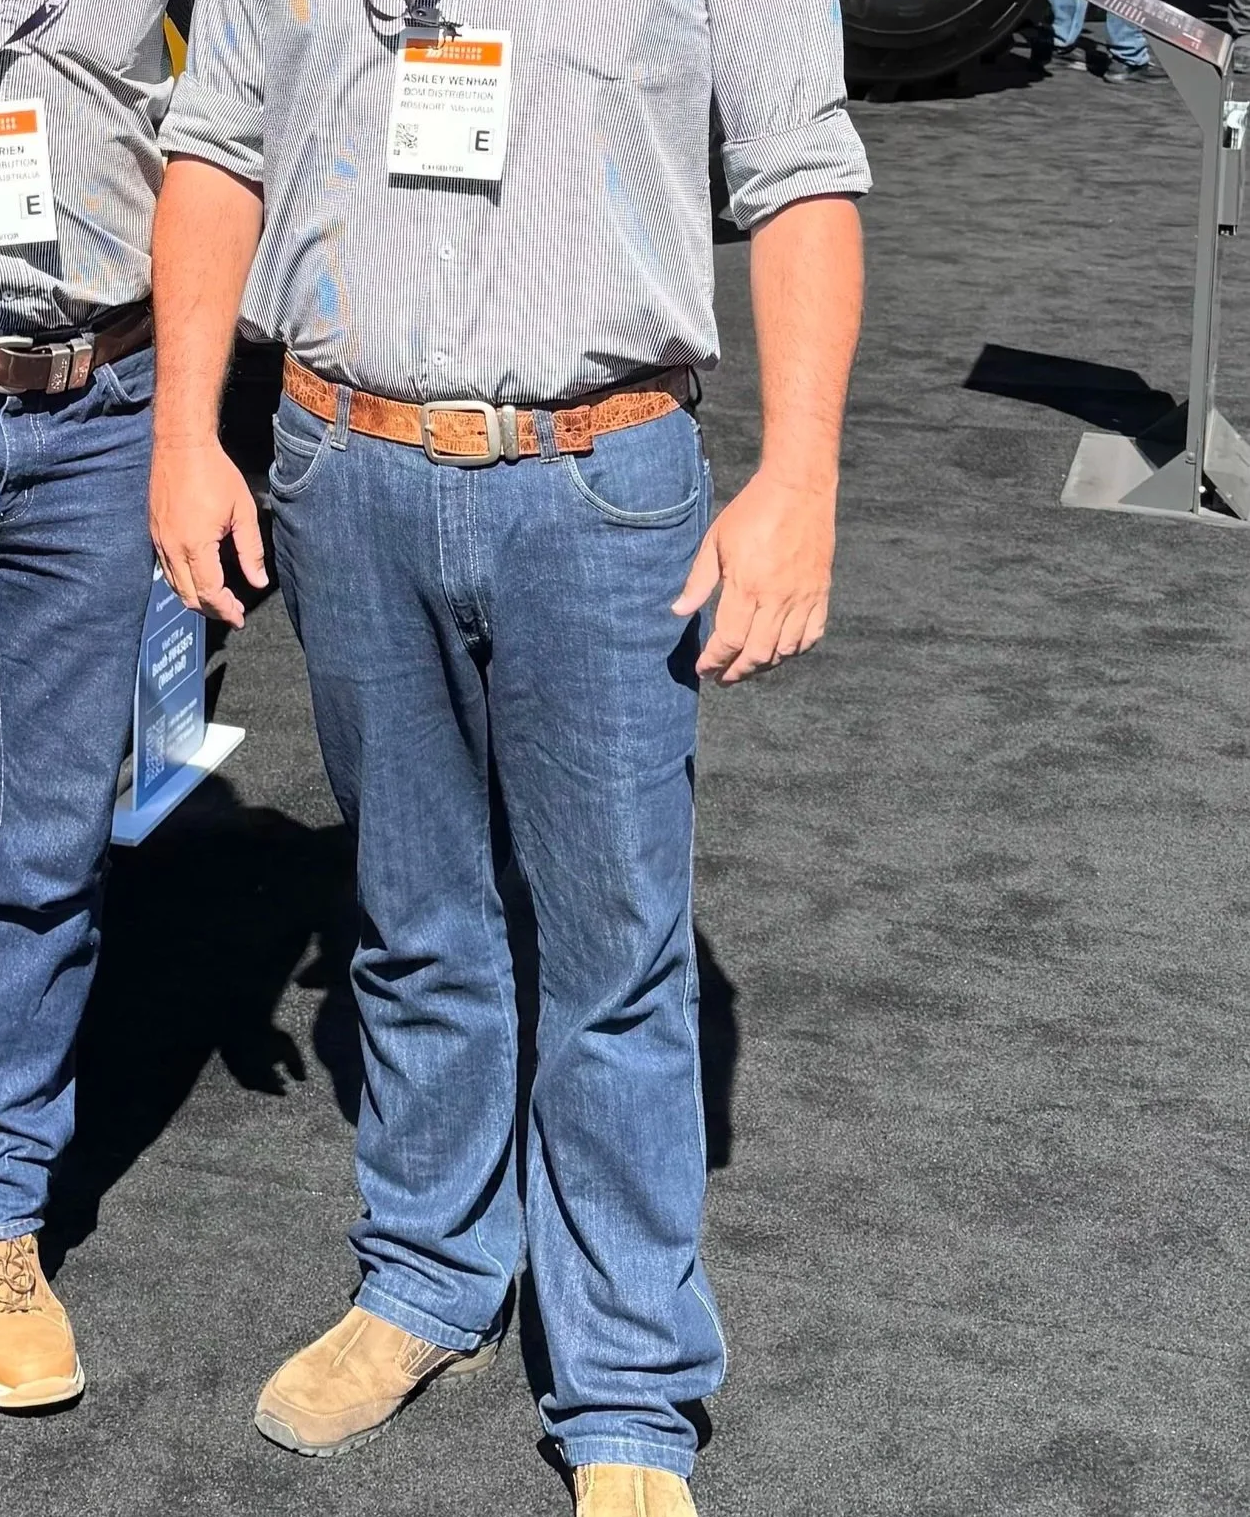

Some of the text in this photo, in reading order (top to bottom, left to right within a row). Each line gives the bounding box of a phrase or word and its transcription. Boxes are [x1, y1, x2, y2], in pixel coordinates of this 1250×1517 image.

[404, 73, 497, 87] ASHLEY WENHAM
[427, 89, 494, 100] DISTRIBUTION
[475, 130, 490, 151] E
[26, 195, 42, 215] E
